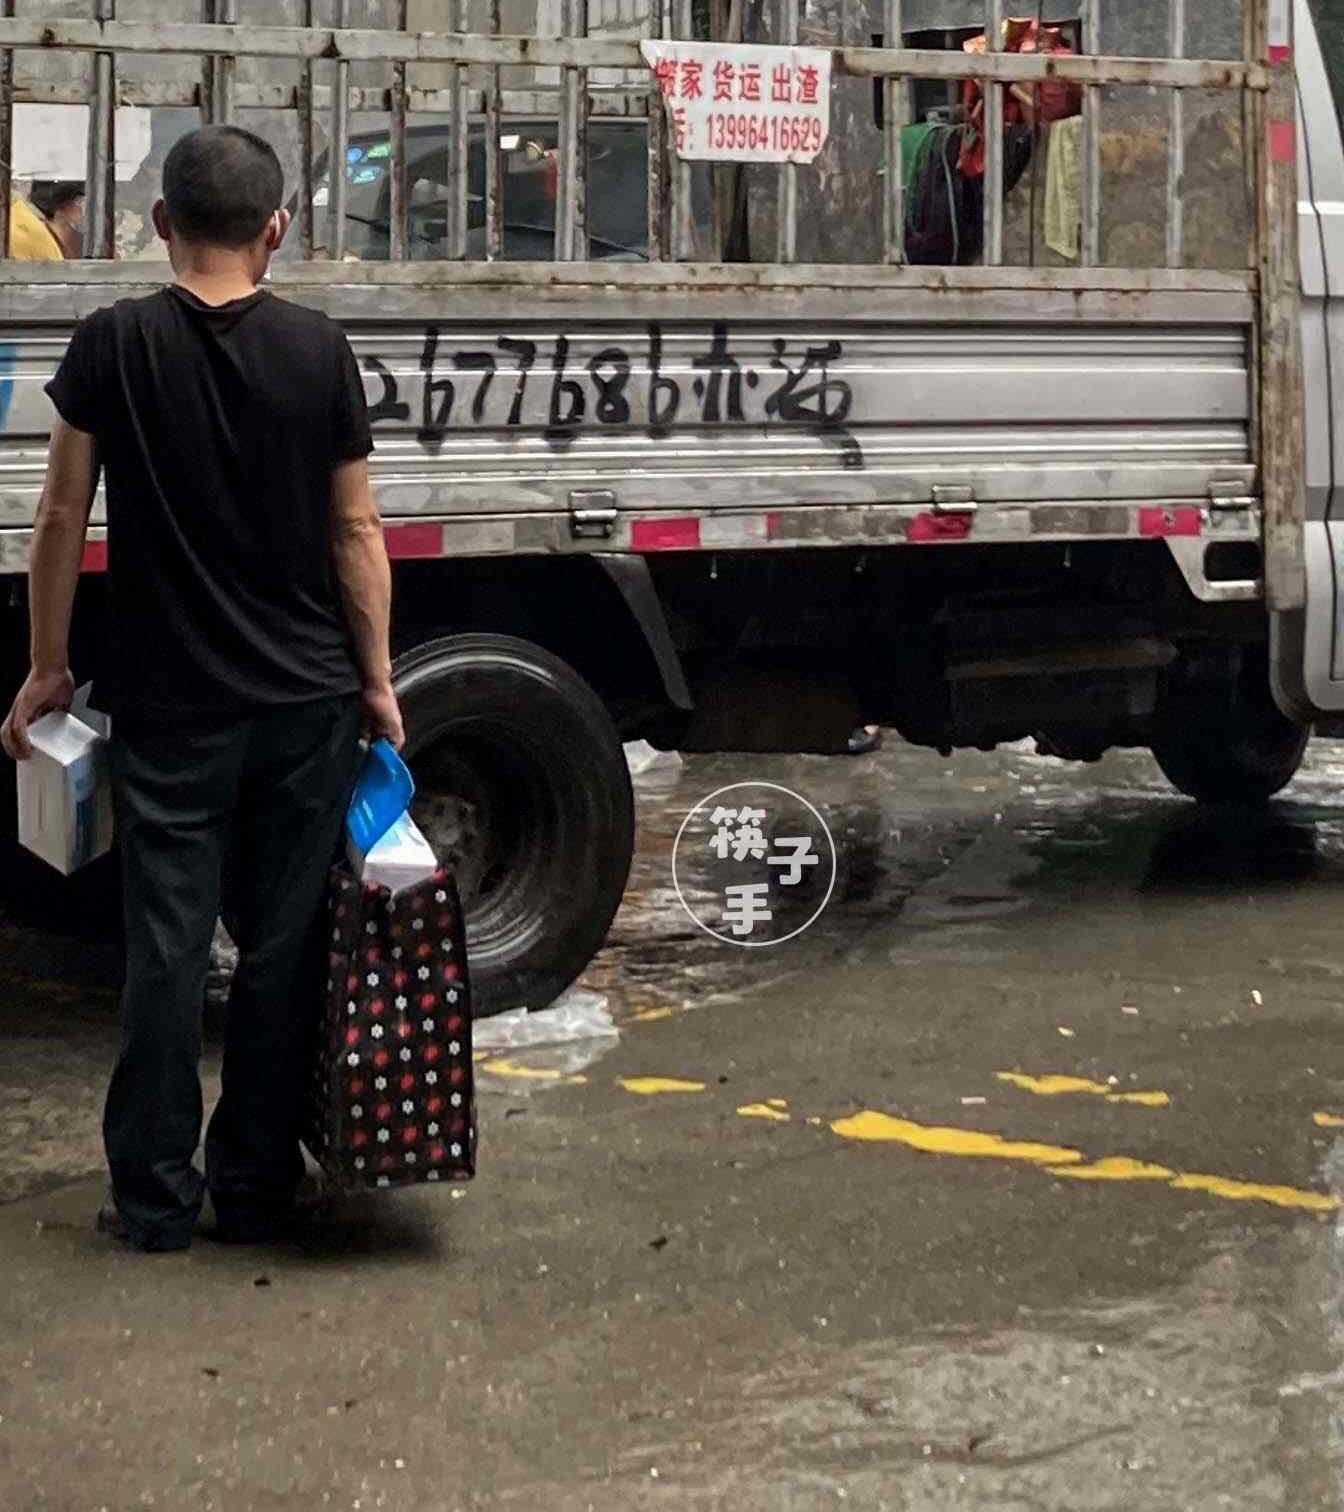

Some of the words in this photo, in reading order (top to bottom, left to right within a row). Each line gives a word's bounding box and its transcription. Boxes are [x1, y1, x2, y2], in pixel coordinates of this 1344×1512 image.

[712, 60, 761, 101] 货运
[771, 63, 819, 104] 出渣
[706, 113, 822, 152] 13996416629
